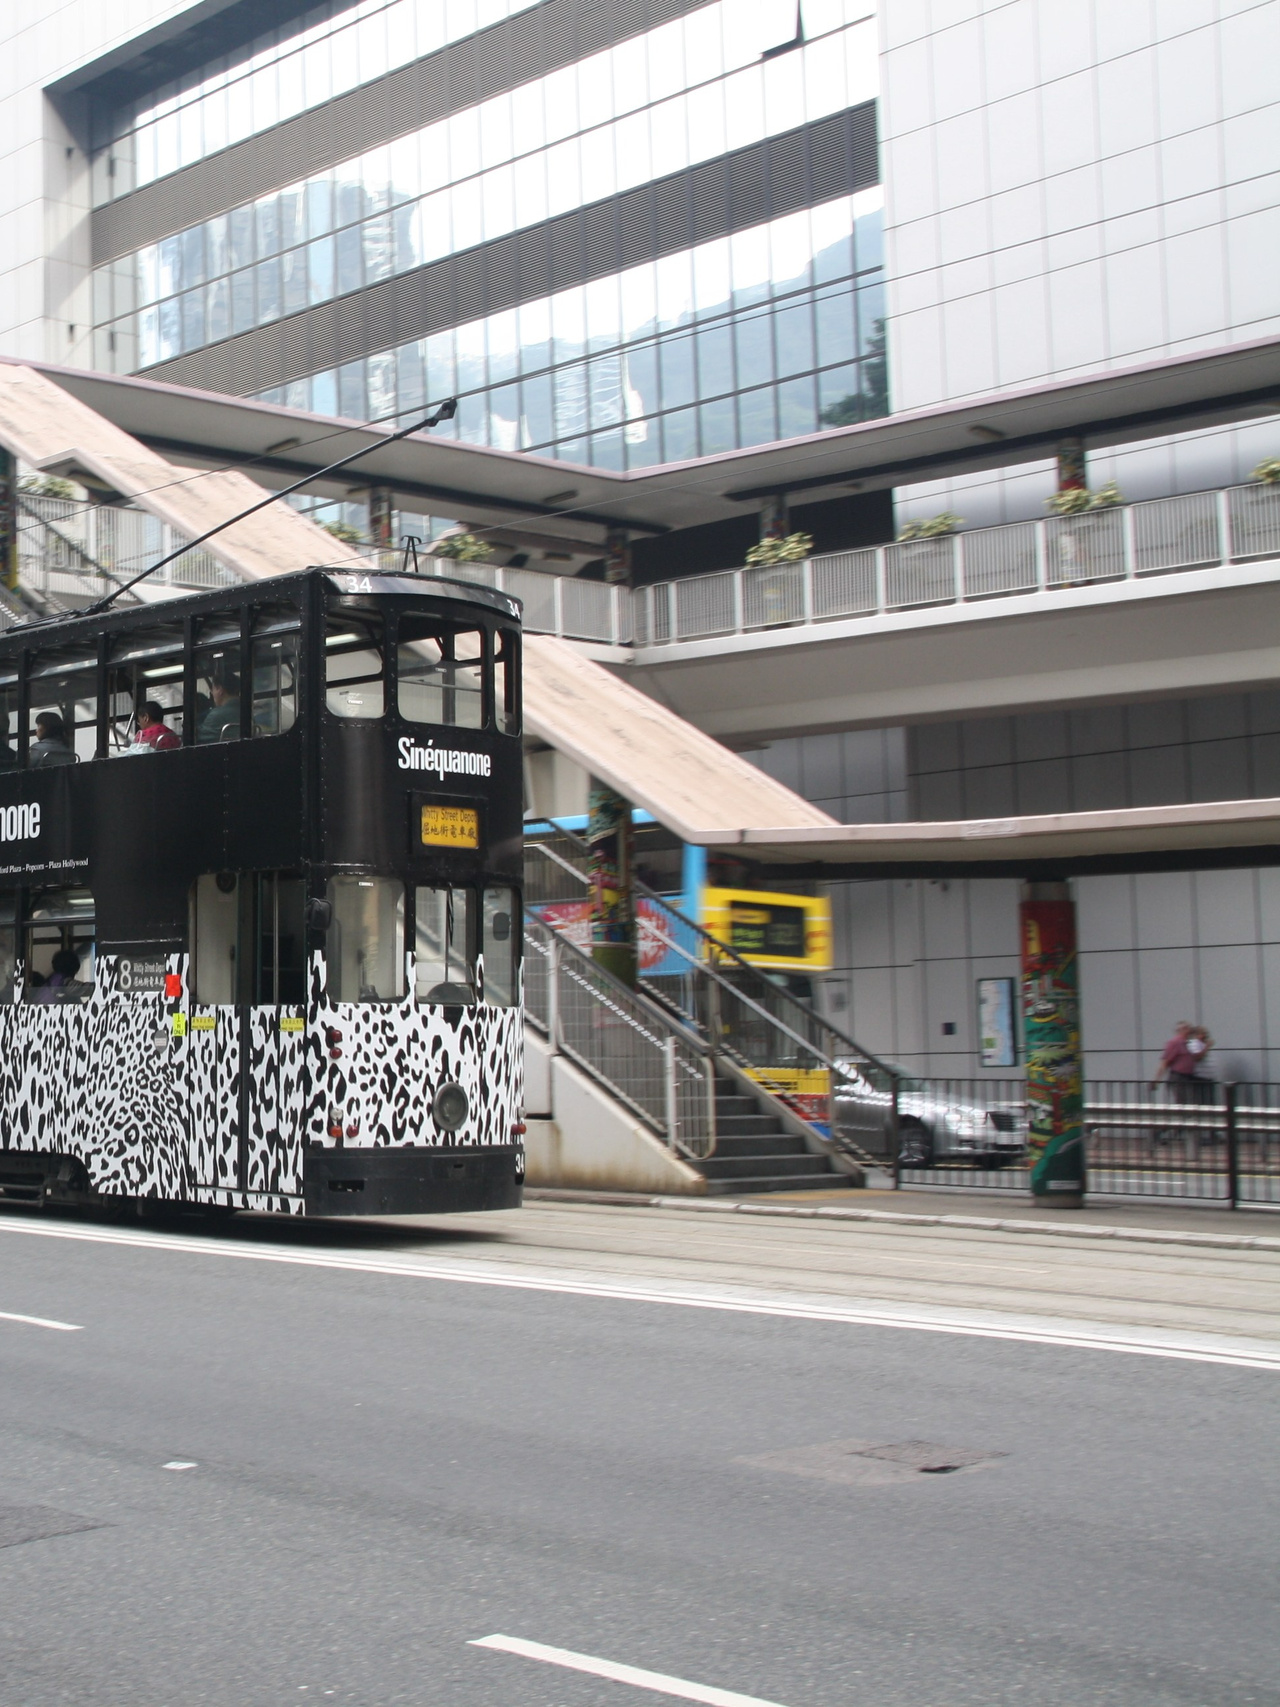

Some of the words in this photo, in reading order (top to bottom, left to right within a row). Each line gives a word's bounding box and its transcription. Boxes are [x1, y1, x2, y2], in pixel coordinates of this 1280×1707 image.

[346, 575, 373, 594] 34
[397, 736, 492, 781] Sinéquanone
[9, 864, 22, 873] Plaza
[25, 863, 45, 873] Popcorn
[48, 860, 61, 869] Plaza
[62, 857, 89, 869] Hollywood
[120, 959, 132, 989] 8
